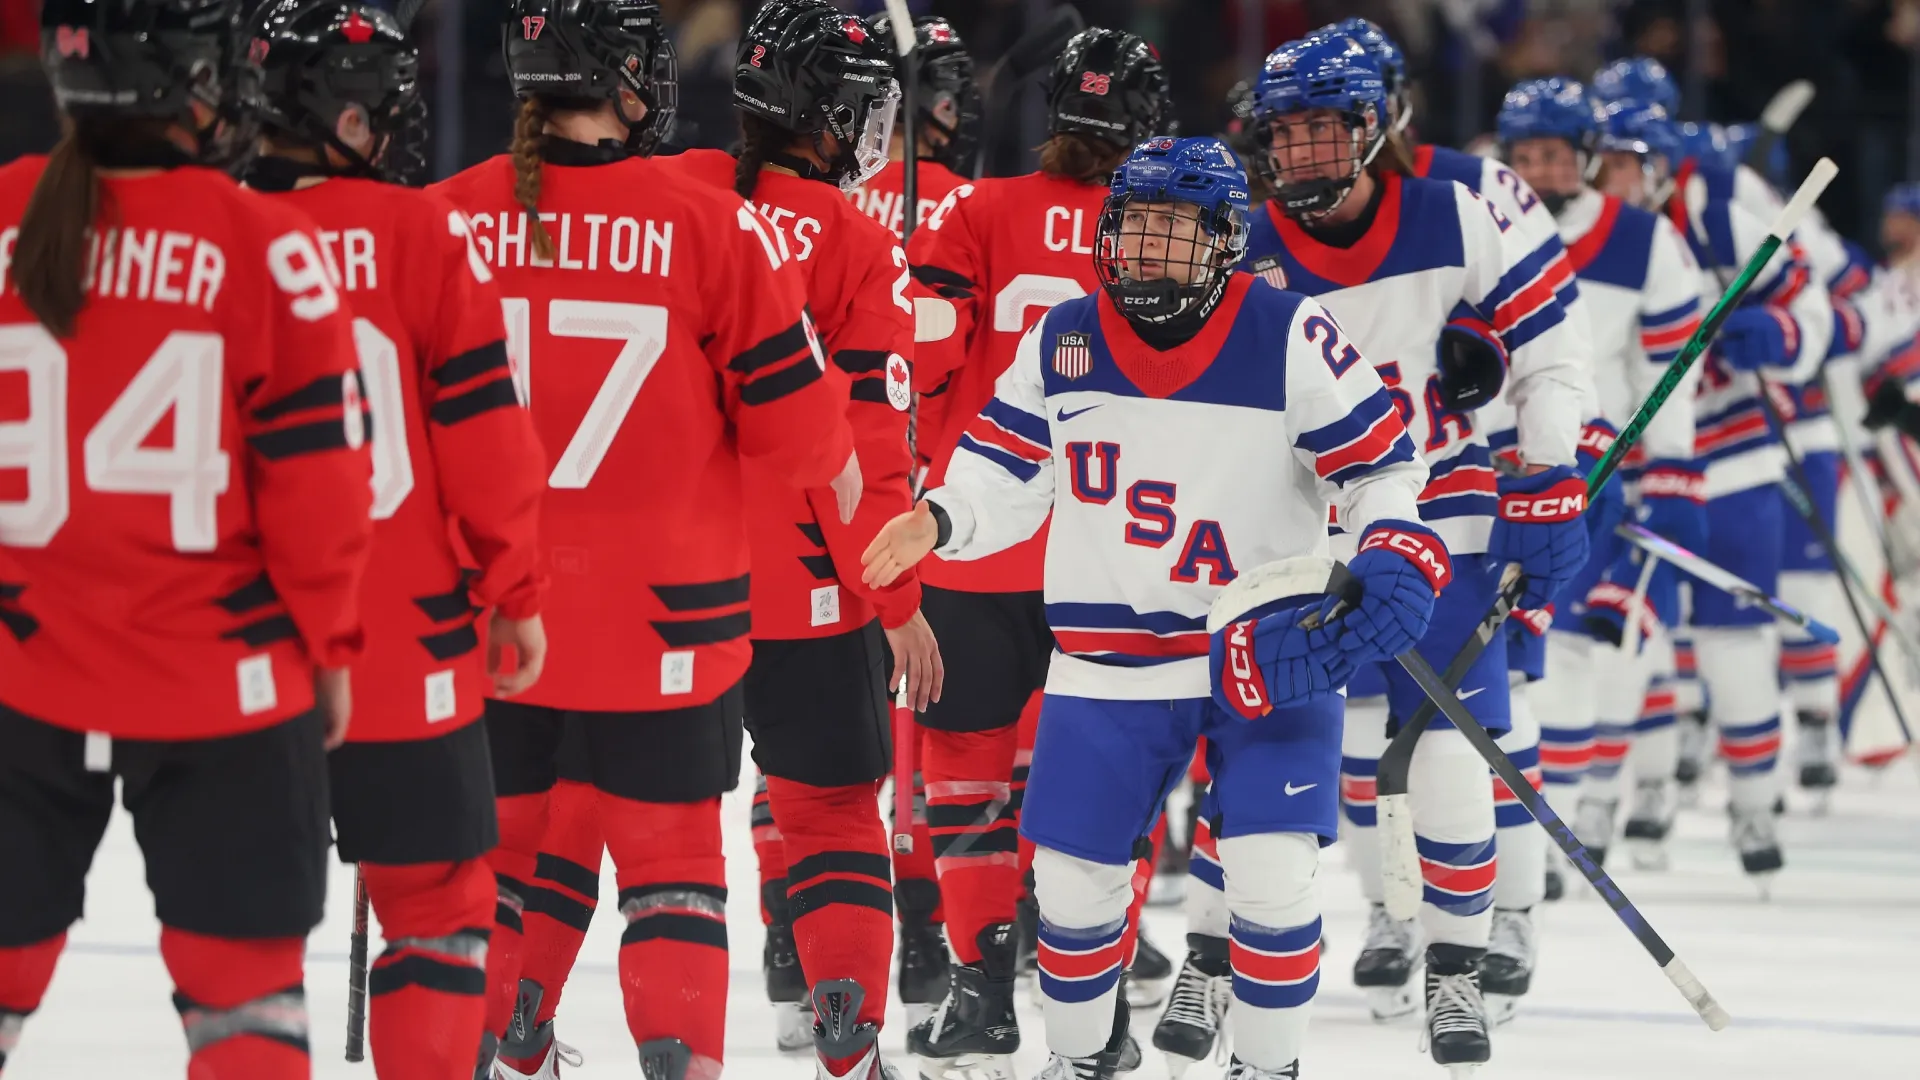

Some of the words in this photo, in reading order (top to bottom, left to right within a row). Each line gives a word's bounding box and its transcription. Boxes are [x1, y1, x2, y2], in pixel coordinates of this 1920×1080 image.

[522, 17, 546, 40] 17
[750, 45, 766, 68] 2
[531, 73, 564, 82] CORTINA
[564, 73, 582, 81] 2026
[843, 72, 875, 83] BAUER
[1080, 71, 1111, 96] 26
[743, 95, 769, 110] CORTINA
[769, 104, 786, 115] 2026
[1228, 190, 1248, 200] CCM
[1287, 195, 1320, 208] CCM
[468, 210, 674, 278] SHELTON
[1123, 296, 1161, 305] CCM
[1200, 276, 1226, 319] CCM
[1061, 336, 1085, 347] USA
[501, 296, 668, 489] 17
[1625, 327, 1708, 444] JETSPEED
[1065, 441, 1239, 586] USA
[1505, 493, 1584, 518] CCM
[1360, 531, 1447, 581] CCM
[1226, 619, 1264, 709] CCM
